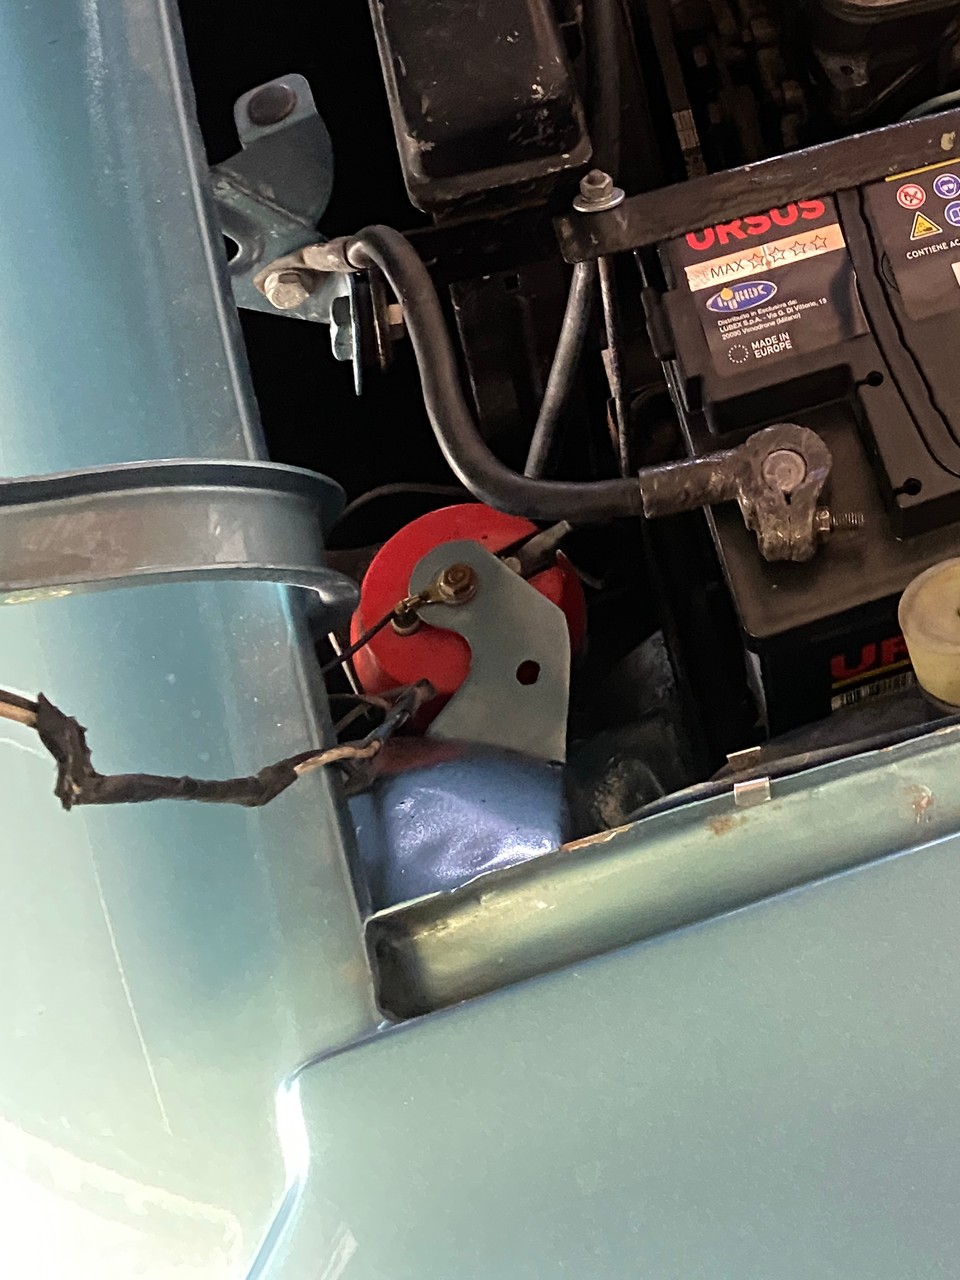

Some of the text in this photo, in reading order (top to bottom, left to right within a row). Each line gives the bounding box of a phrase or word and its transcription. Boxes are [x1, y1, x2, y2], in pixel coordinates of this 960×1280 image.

[685, 199, 826, 250] URSUS
[906, 242, 949, 260] CONTIENE
[710, 260, 745, 279] MAX
[751, 331, 790, 351] MADE IN
[754, 339, 793, 359] EUROPE
